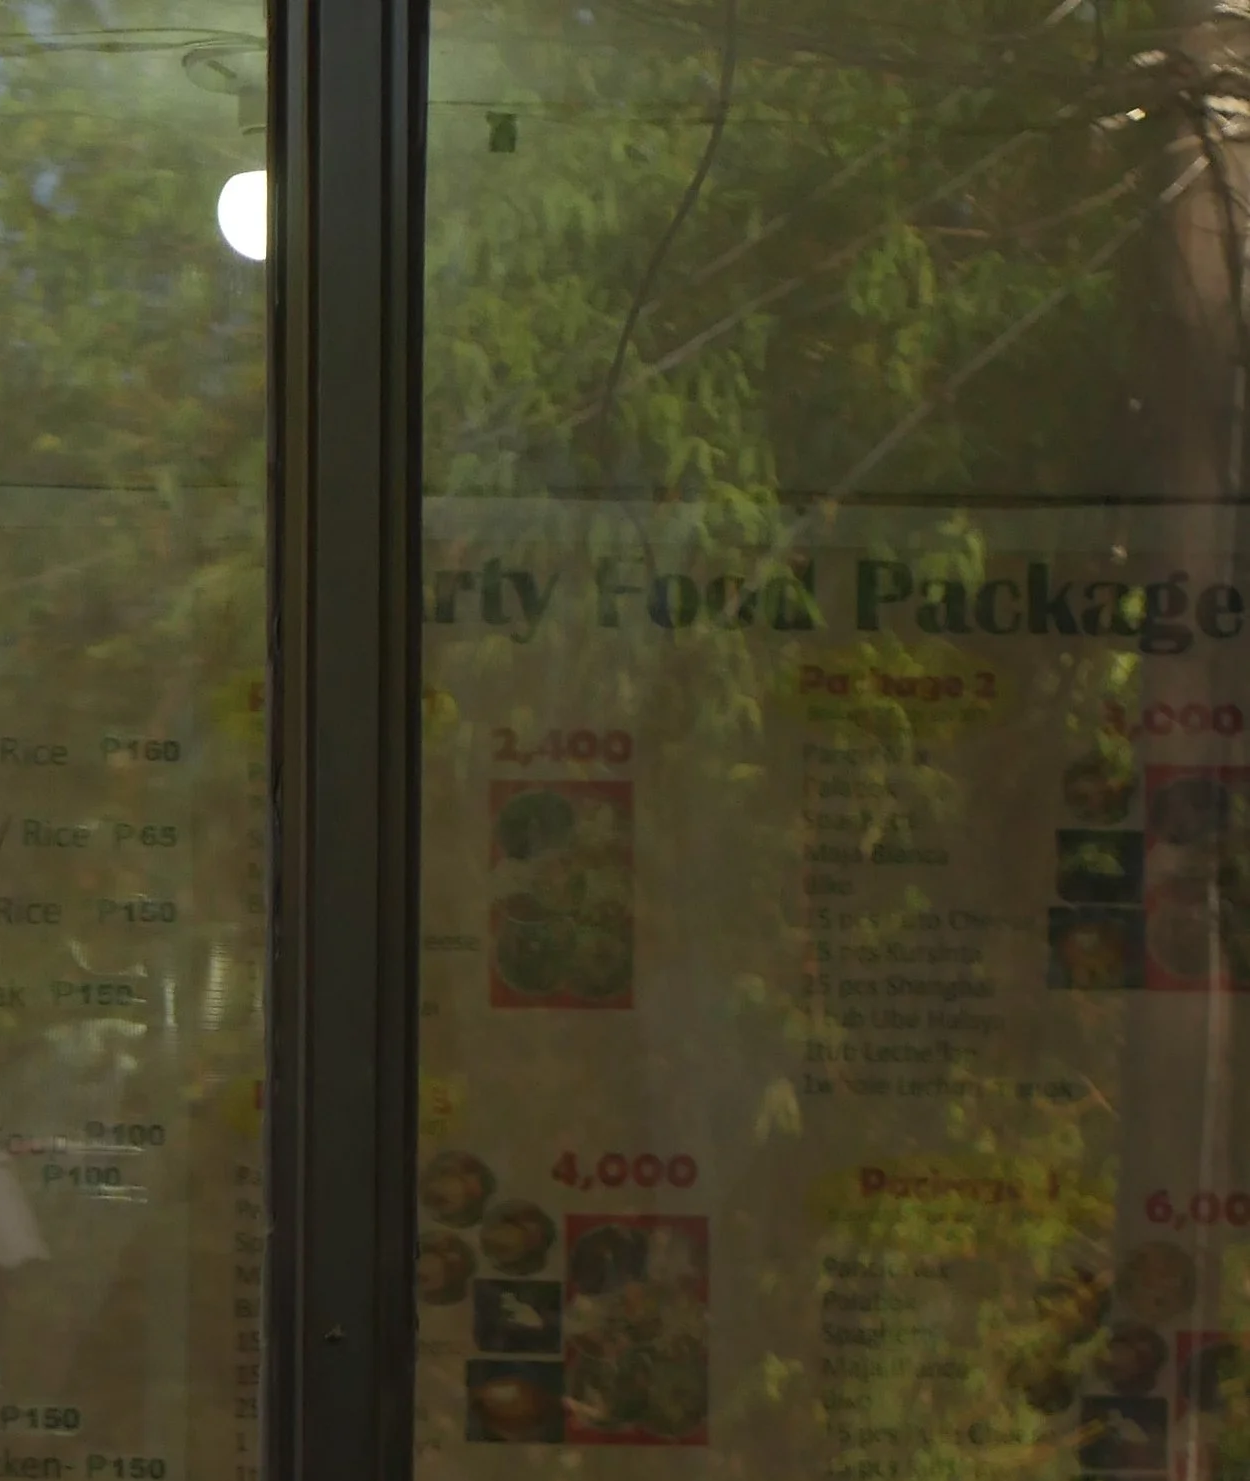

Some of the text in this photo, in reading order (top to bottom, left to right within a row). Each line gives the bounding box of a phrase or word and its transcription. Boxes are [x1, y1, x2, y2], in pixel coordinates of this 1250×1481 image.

[856, 560, 1244, 655] Package
[974, 672, 997, 698] 2
[0, 737, 69, 766] Rice
[22, 818, 90, 849] Rice
[552, 1151, 697, 1190] 4,000
